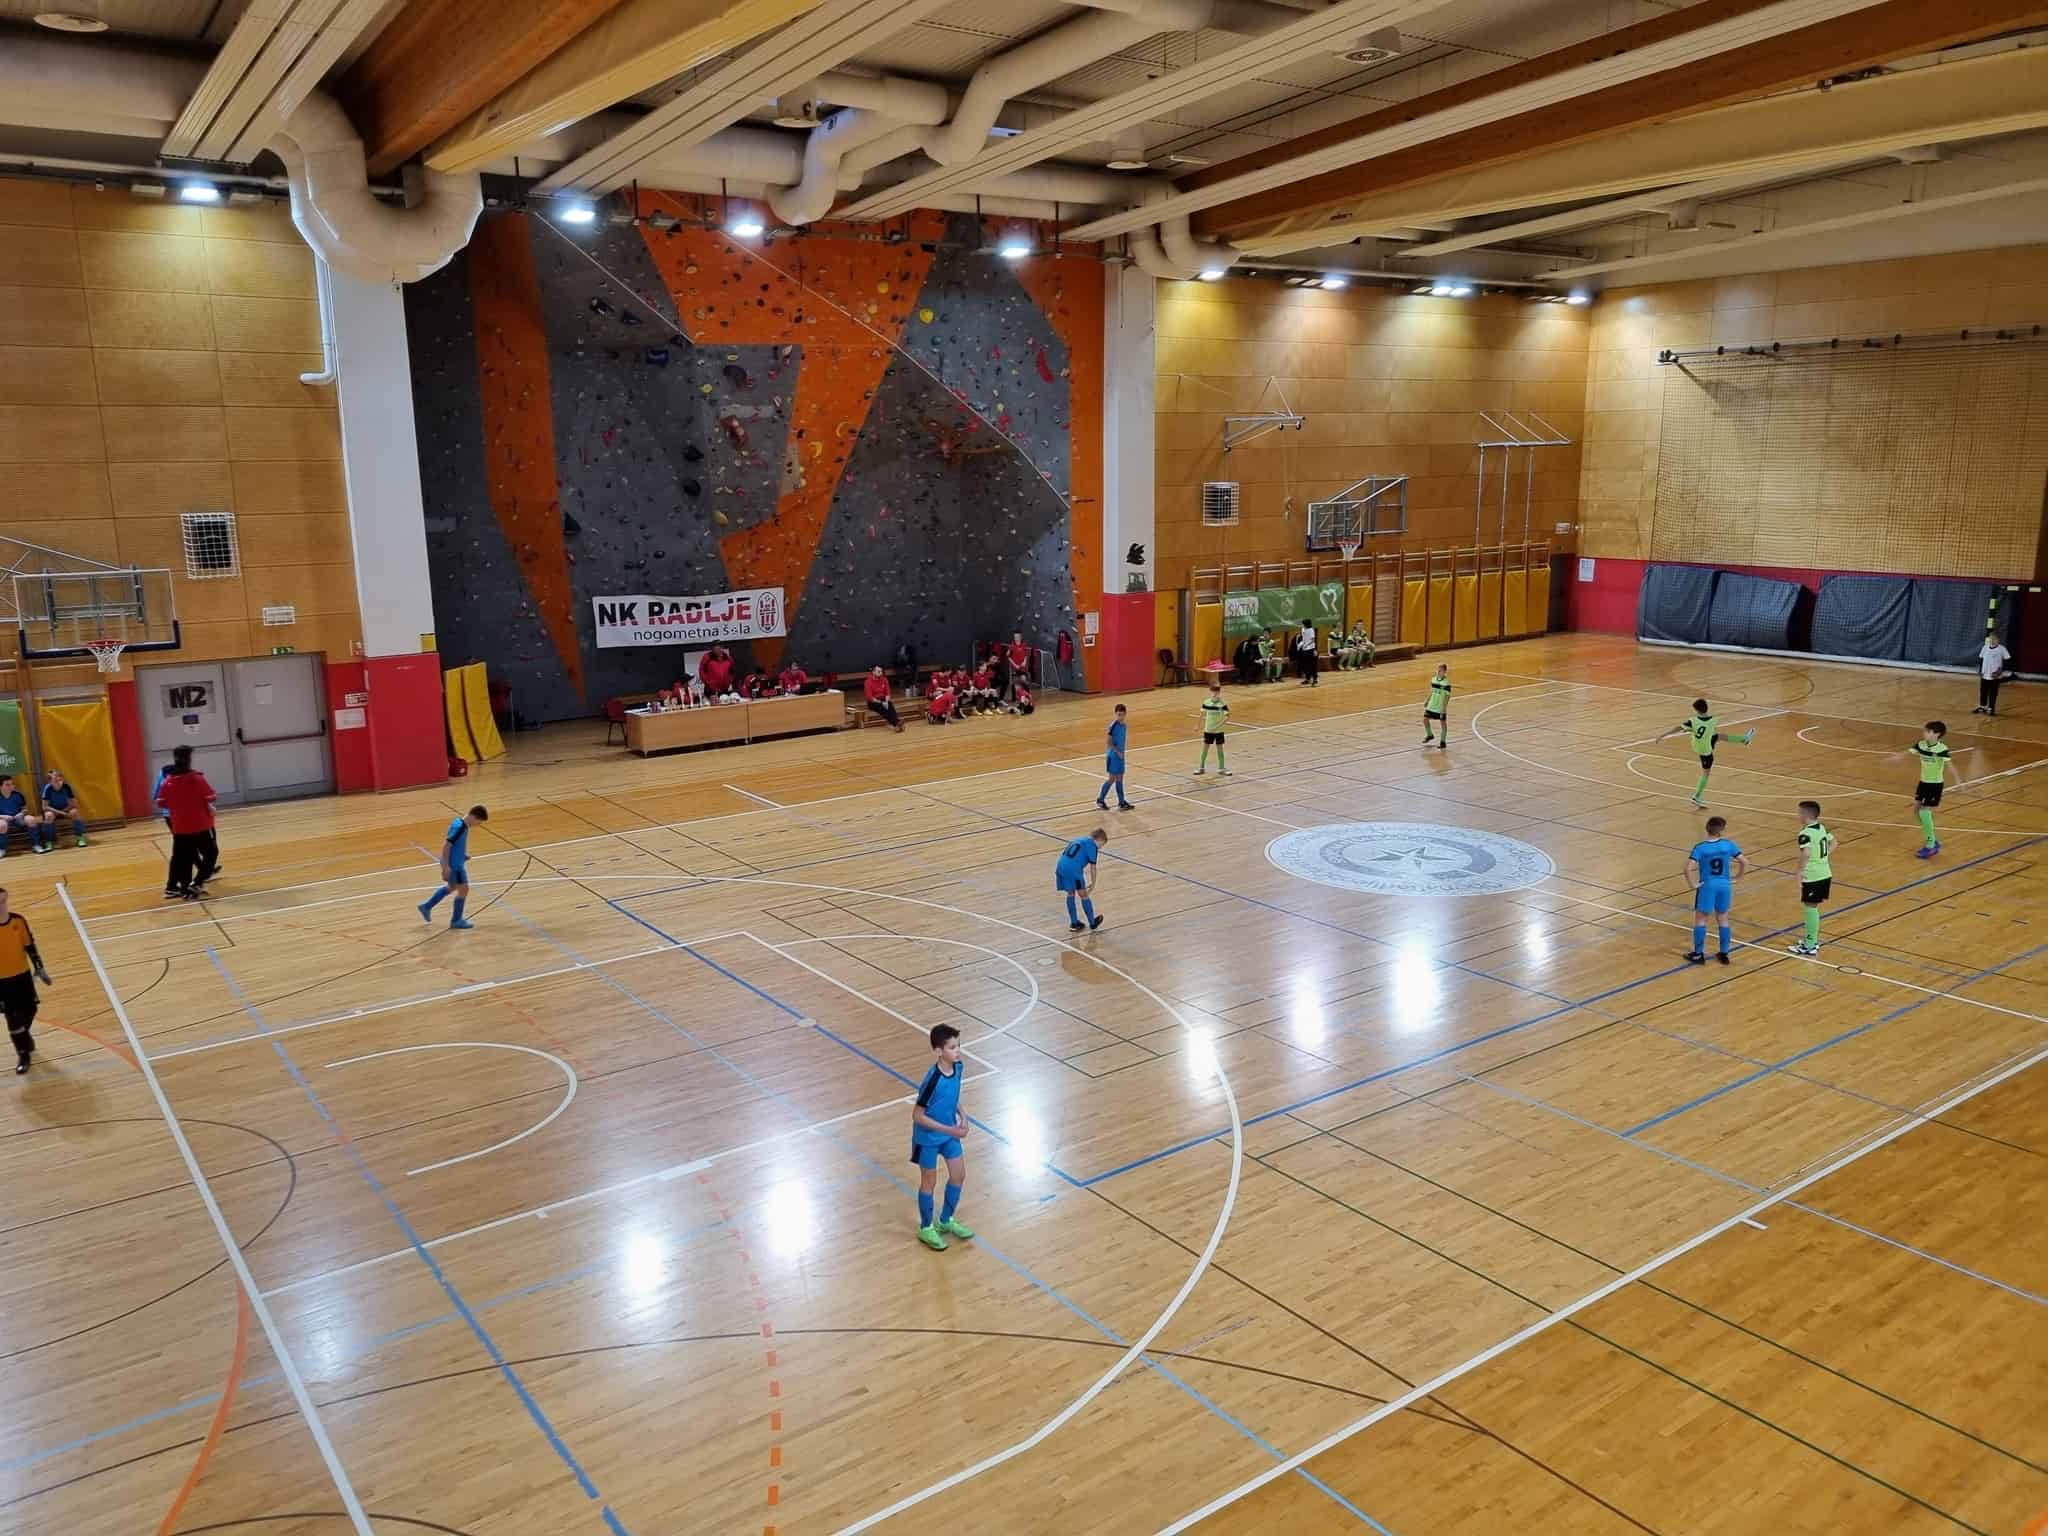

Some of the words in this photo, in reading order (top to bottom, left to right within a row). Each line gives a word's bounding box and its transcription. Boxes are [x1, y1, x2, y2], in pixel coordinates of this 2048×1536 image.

[597, 602, 638, 627] NK
[648, 597, 752, 625] RADLJE
[634, 626, 719, 641] nogometna
[169, 686, 207, 709] M2
[1695, 726, 1706, 739] 9
[1709, 857, 1724, 876] 9
